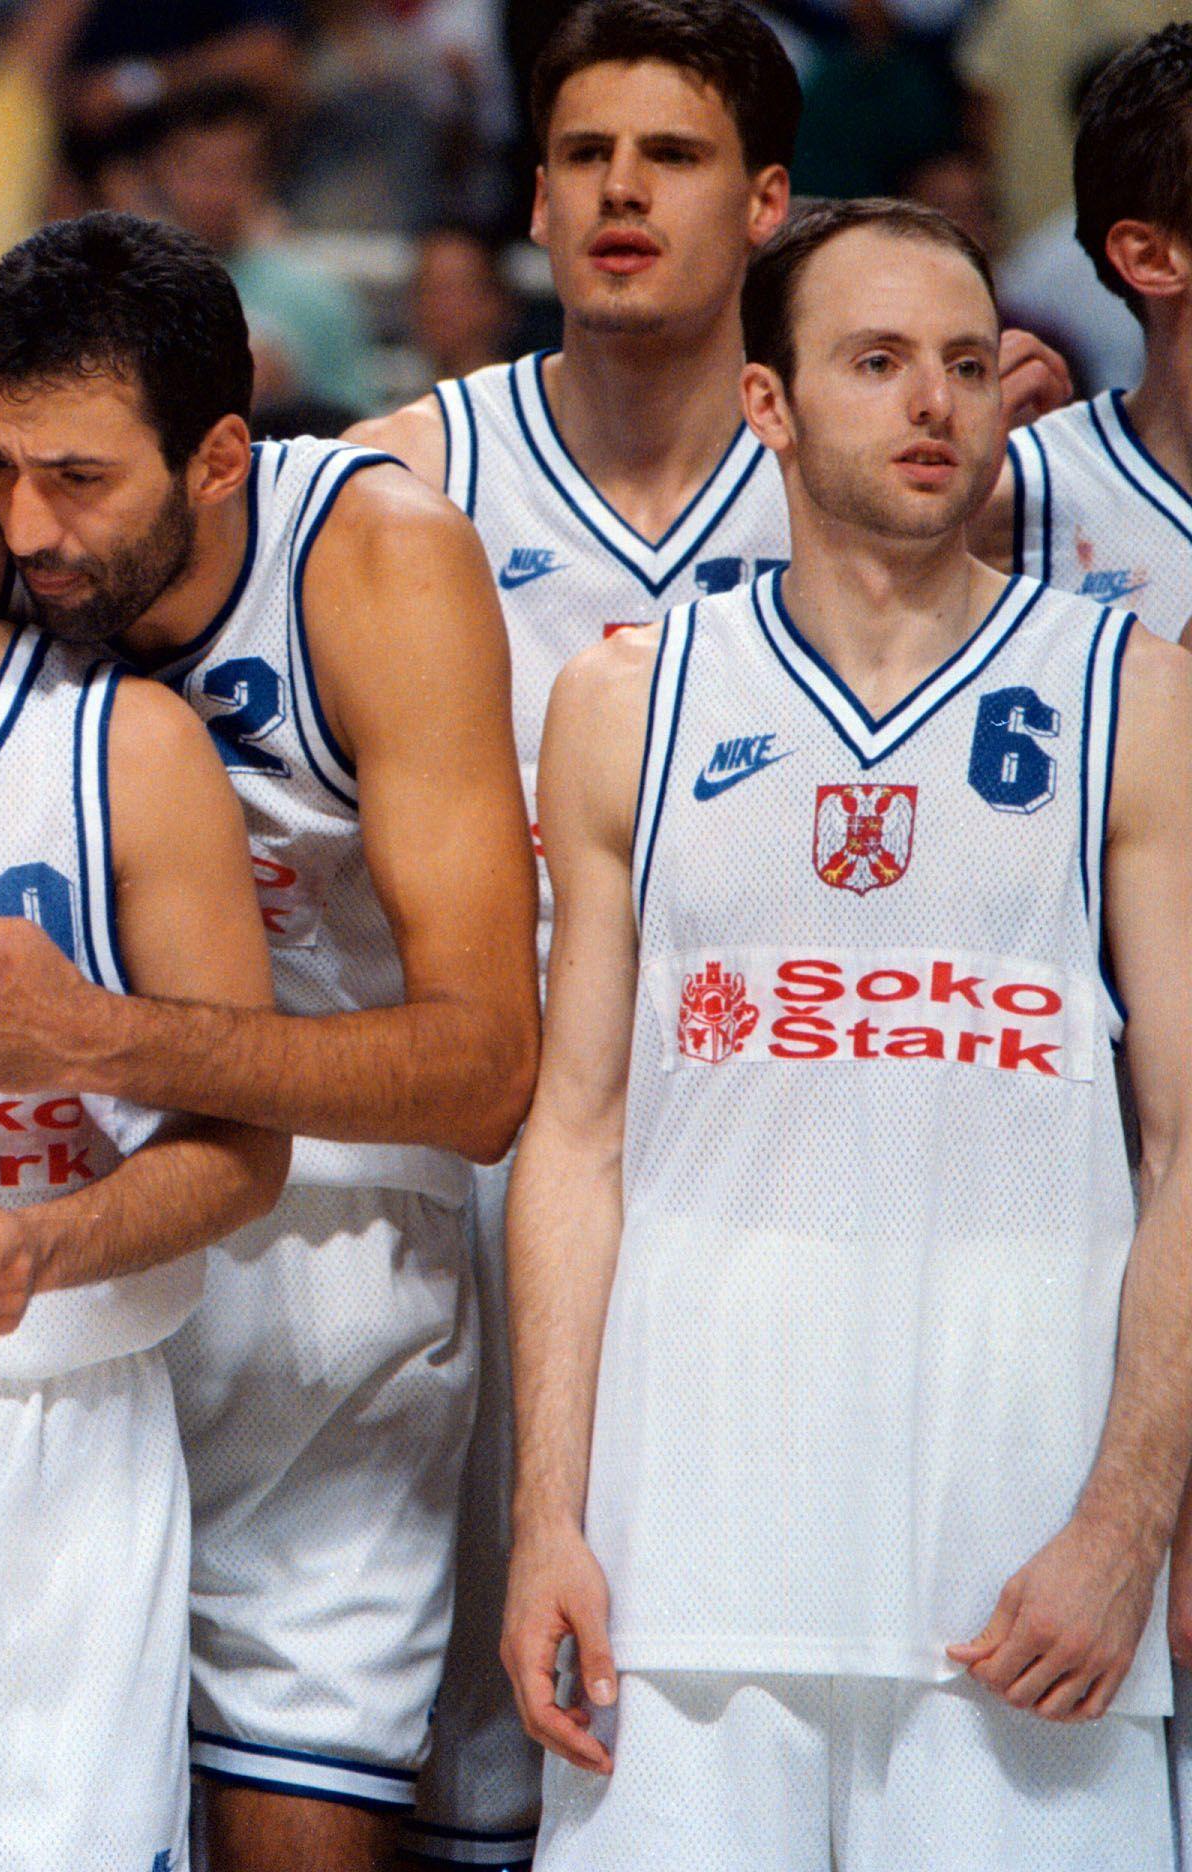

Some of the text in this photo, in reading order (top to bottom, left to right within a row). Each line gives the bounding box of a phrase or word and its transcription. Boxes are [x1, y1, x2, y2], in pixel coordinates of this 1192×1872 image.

[508, 548, 555, 570] NIKE
[708, 732, 777, 773] NIKE
[967, 686, 1061, 815] 6
[772, 960, 1062, 1017] Soko
[768, 1005, 1062, 1076] Štark
